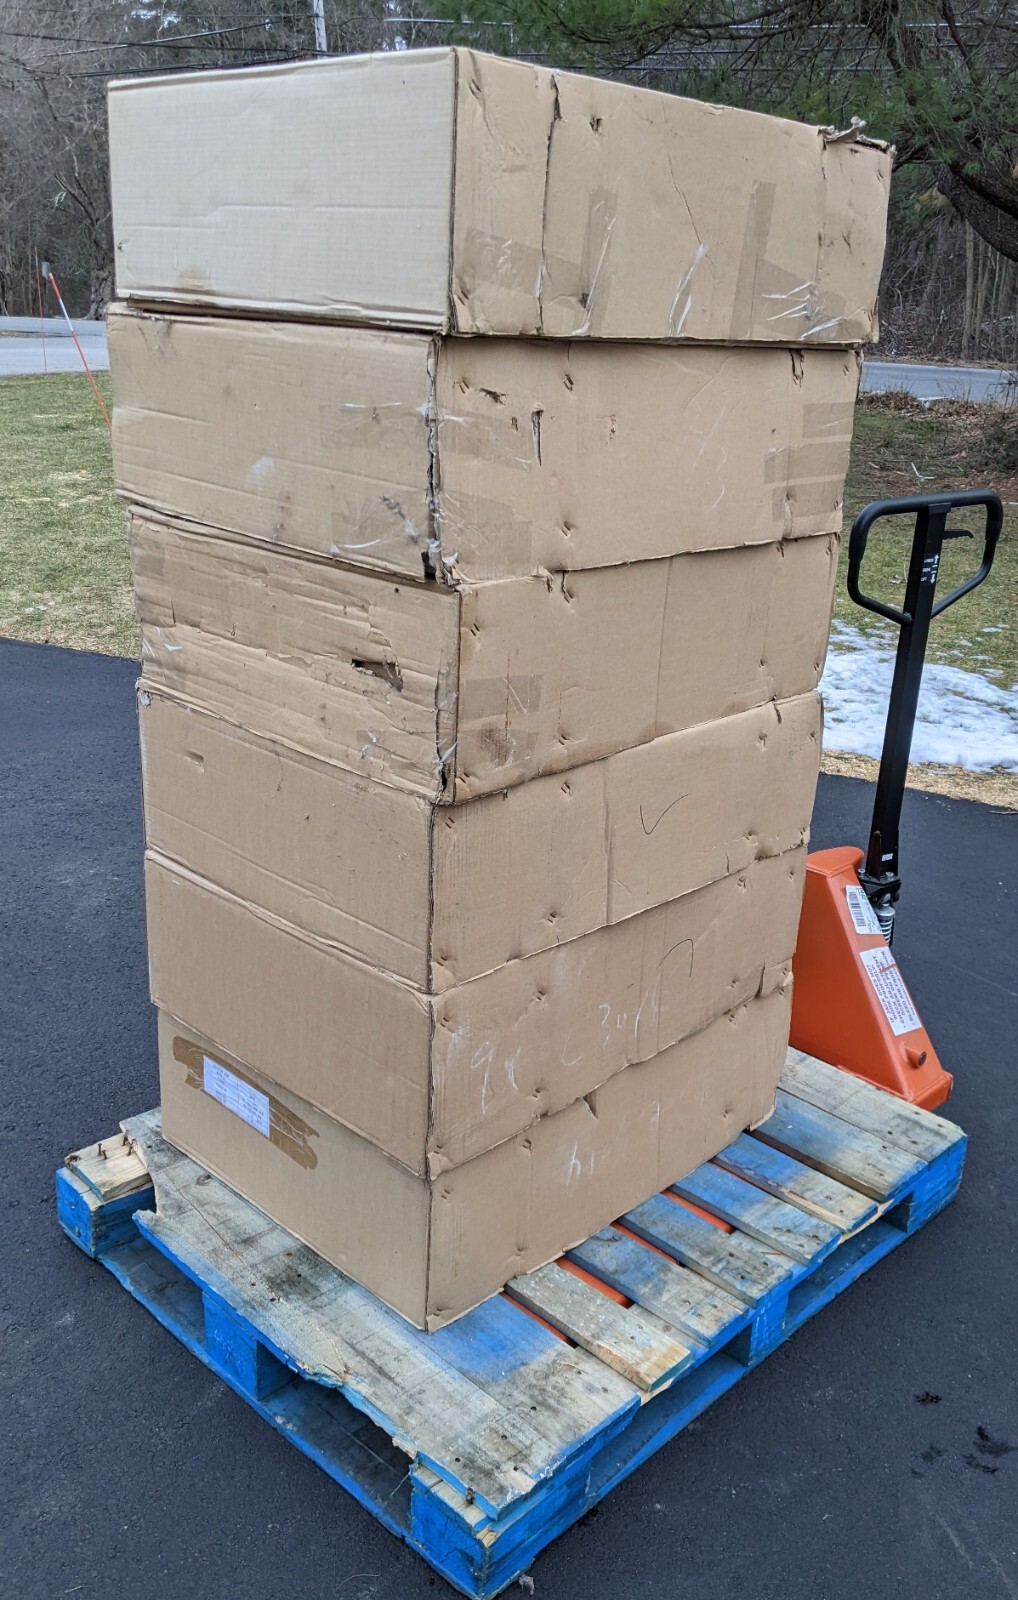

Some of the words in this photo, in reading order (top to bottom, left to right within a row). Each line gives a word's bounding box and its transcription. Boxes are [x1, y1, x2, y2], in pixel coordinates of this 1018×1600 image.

[866, 964, 875, 977] NOT
[872, 979, 883, 996] DOES
[881, 998, 891, 1015] JACK
[887, 1001, 898, 1020] WORK
[892, 1001, 905, 1024] CHECK
[893, 993, 906, 1015] SCREW
[902, 1000, 914, 1021] BLEED
